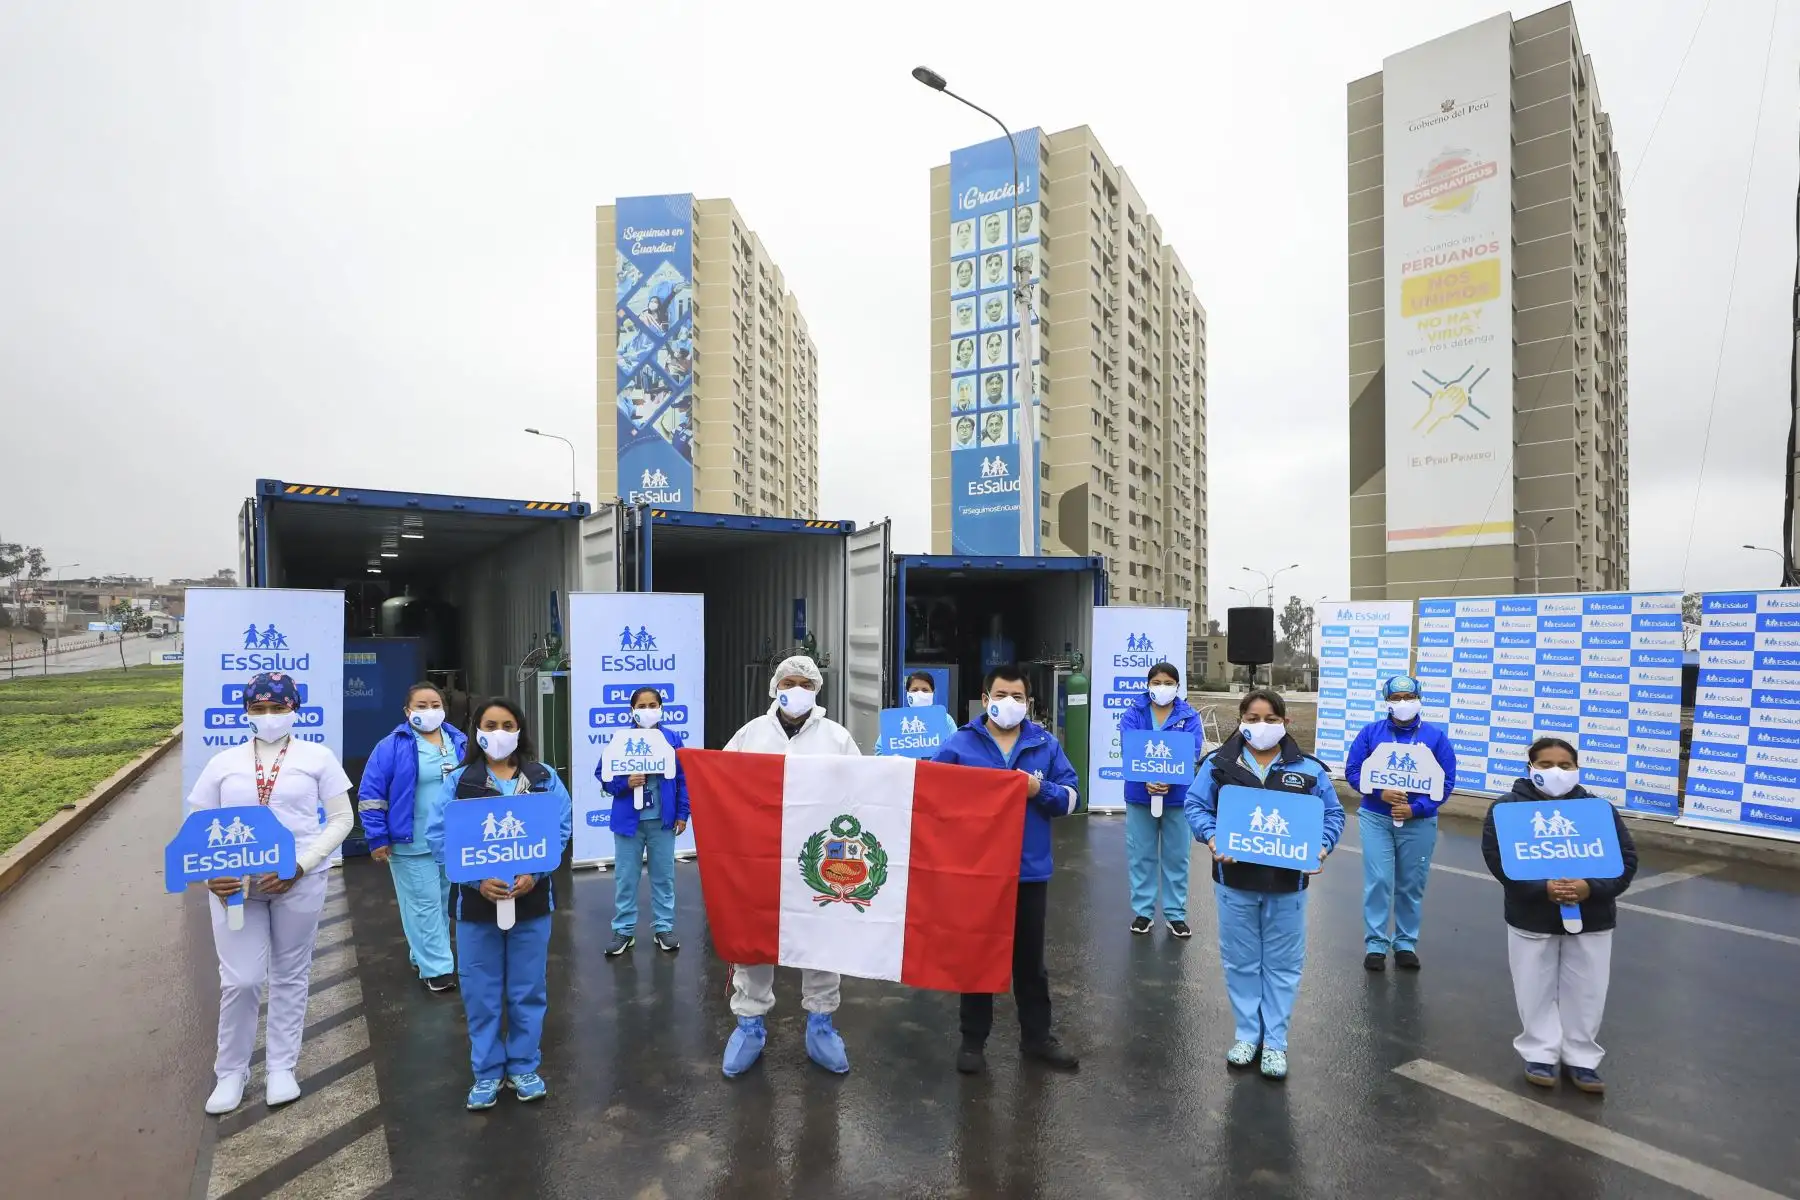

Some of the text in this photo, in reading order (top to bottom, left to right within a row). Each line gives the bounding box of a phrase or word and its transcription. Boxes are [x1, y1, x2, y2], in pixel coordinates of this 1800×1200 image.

[1409, 114, 1449, 132] Gobierno
[1451, 108, 1465, 118] del
[1407, 167, 1493, 202] CORONAVIRUS
[671, 228, 684, 237] en
[1402, 240, 1500, 274] PERUANOS
[1429, 271, 1471, 290] NOS
[1410, 282, 1490, 310] UNIMOS
[1417, 308, 1482, 330] NO HAY
[1428, 325, 1475, 343] VIRUS
[1450, 333, 1495, 349] detenga
[968, 476, 1021, 495] EsSalud
[629, 489, 681, 504] EsSalud
[1355, 612, 1391, 621] EsSalud
[221, 653, 310, 671] EsSalud
[602, 654, 675, 672] EsSalud
[1107, 698, 1122, 706] DE
[212, 714, 236, 725] DE
[595, 713, 615, 724] DE
[203, 735, 249, 746] VILLA
[889, 733, 940, 750] EsSalud
[611, 758, 665, 772] EsSalud
[1131, 759, 1185, 775] EsSalud
[1370, 770, 1433, 791] EsSalud
[1708, 788, 1734, 796] EsSalud
[461, 838, 547, 867] EsSalud
[1228, 832, 1308, 861] EsSalud
[1514, 837, 1604, 860] EsSalud
[183, 843, 279, 874] EsSalud
